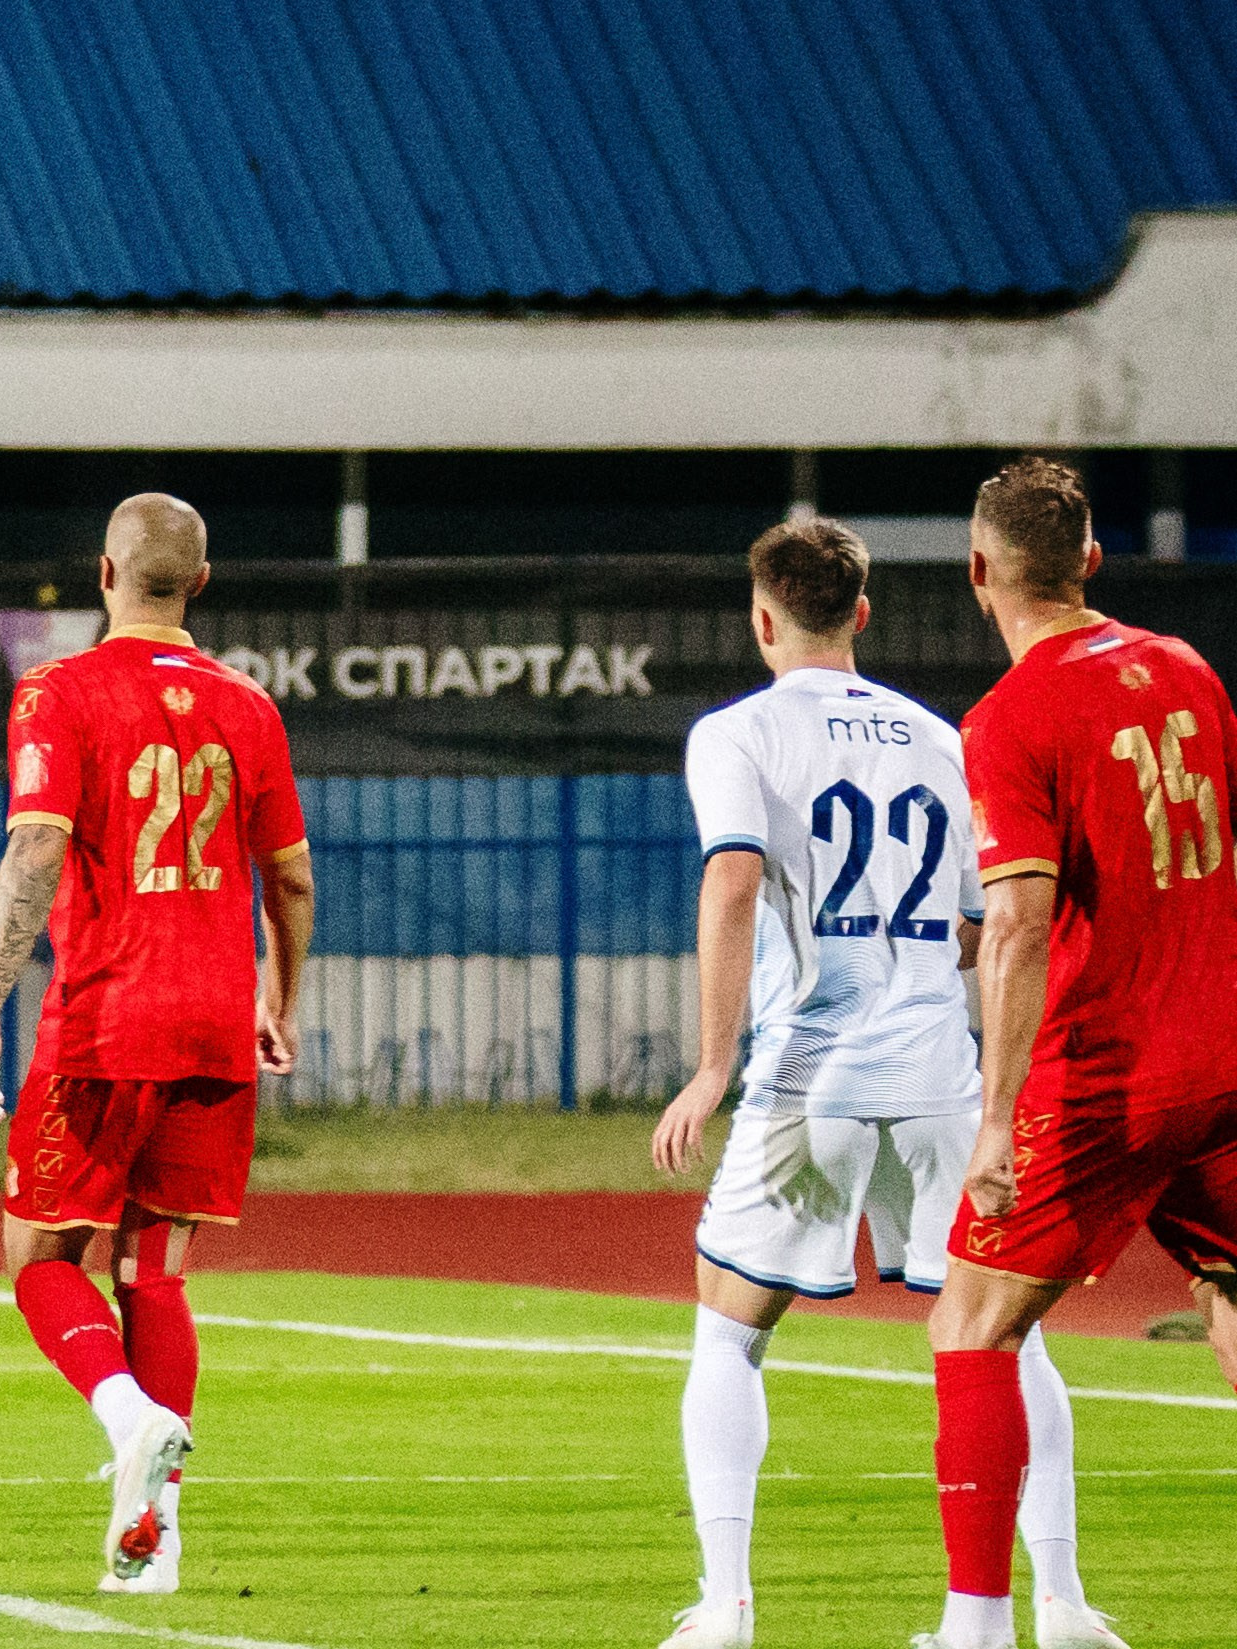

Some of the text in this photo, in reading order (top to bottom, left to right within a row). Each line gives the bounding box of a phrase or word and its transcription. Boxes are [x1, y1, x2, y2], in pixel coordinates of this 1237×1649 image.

[333, 644, 653, 698] СПАРТАК
[827, 713, 912, 746] mts
[127, 743, 234, 894] 22
[812, 778, 950, 942] 22
[1111, 710, 1222, 890] 15
